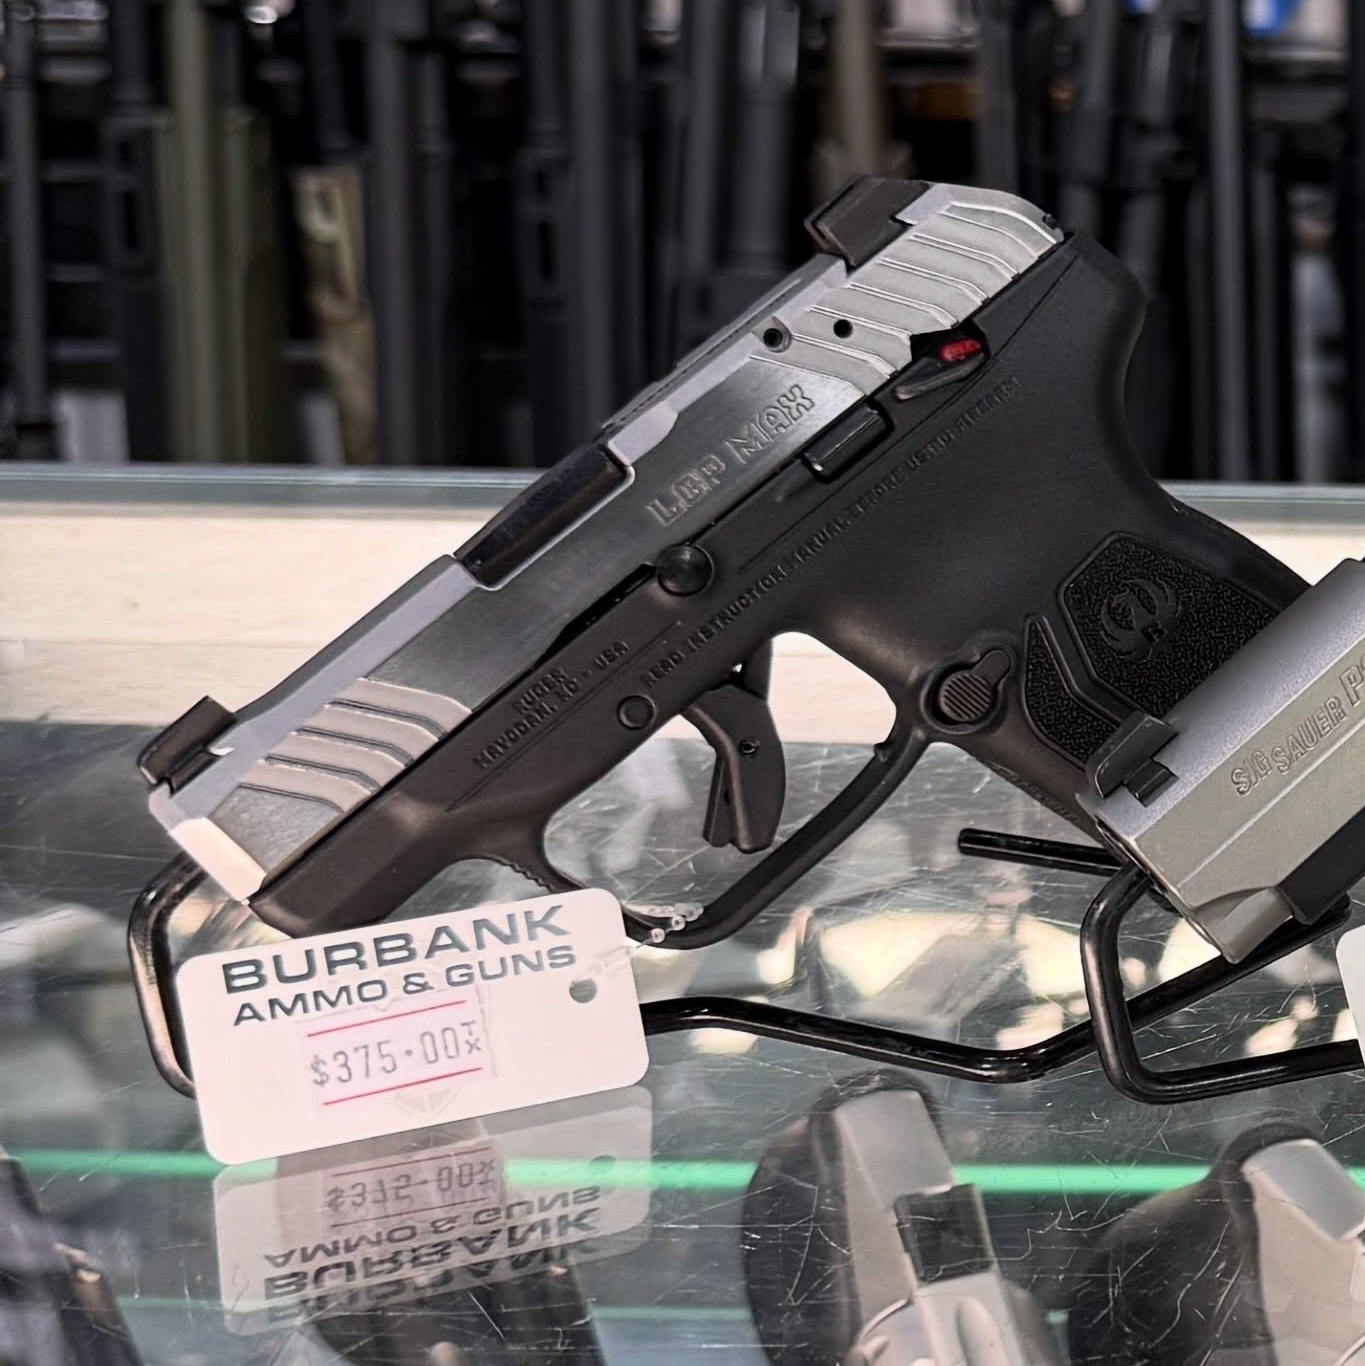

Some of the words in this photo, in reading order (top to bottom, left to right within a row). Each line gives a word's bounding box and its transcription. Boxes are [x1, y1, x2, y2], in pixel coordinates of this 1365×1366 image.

[726, 383, 816, 466] MAX
[688, 565, 788, 650] INSTRUCTION
[593, 639, 631, 668] USA
[1230, 750, 1273, 796] SIG
[1270, 695, 1348, 775] SAUER
[222, 904, 572, 995] BURBANK
[232, 978, 389, 1027] AMMO
[402, 972, 435, 996] &
[445, 944, 577, 988] GUNS
